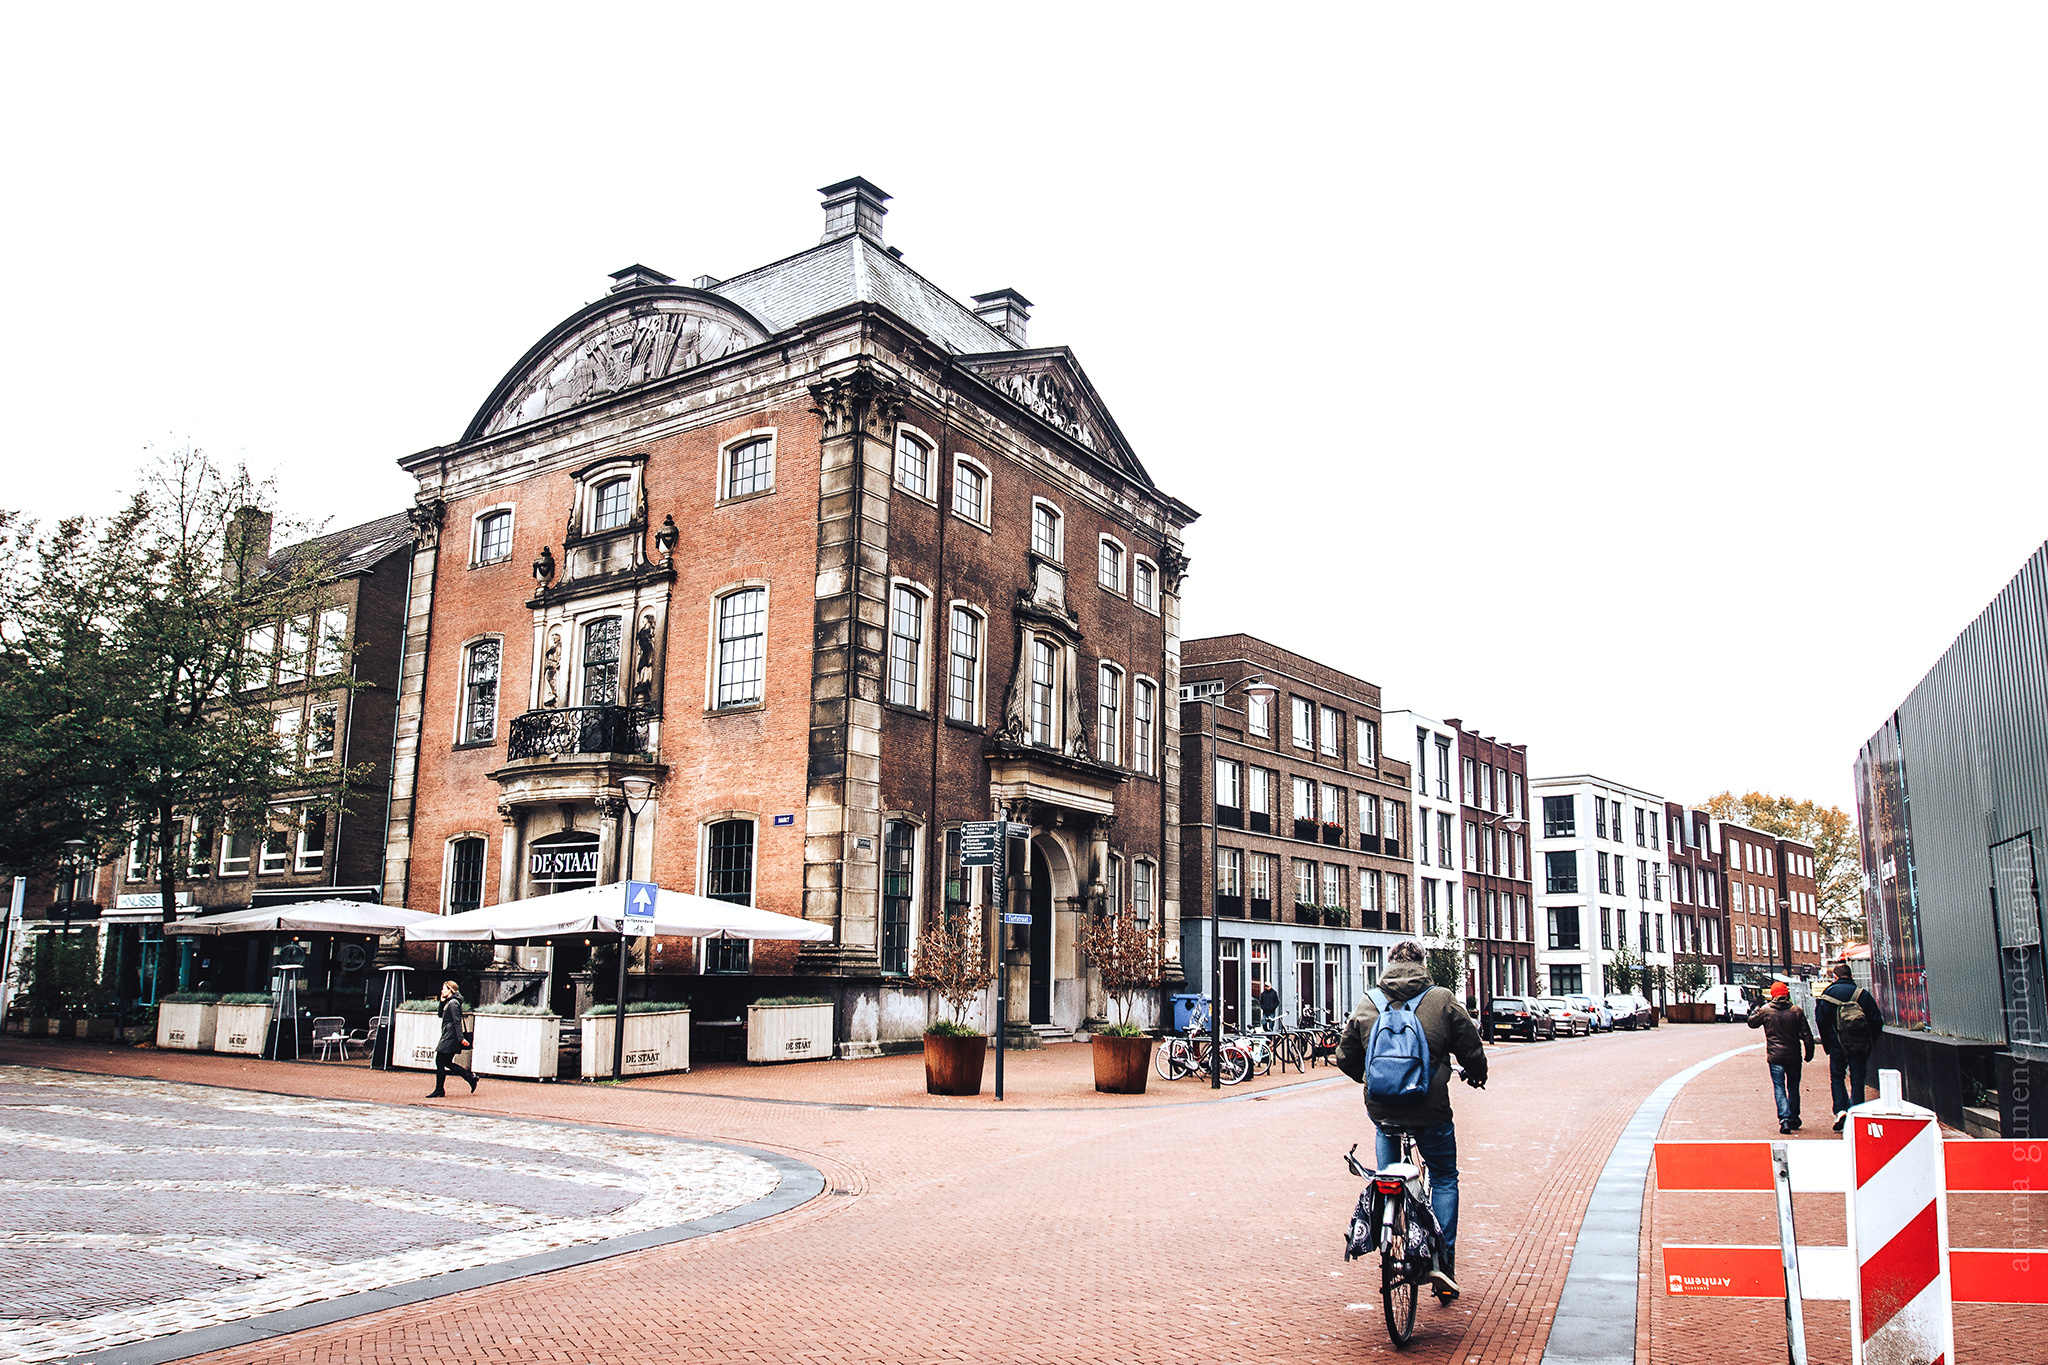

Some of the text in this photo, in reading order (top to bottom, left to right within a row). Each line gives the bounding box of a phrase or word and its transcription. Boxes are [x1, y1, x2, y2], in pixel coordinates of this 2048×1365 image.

[531, 852, 599, 874] DE STAAT
[785, 1041, 811, 1050] DE STAAT
[625, 1052, 660, 1064] DE STAAT
[1683, 1276, 1731, 1287] Arnhem
